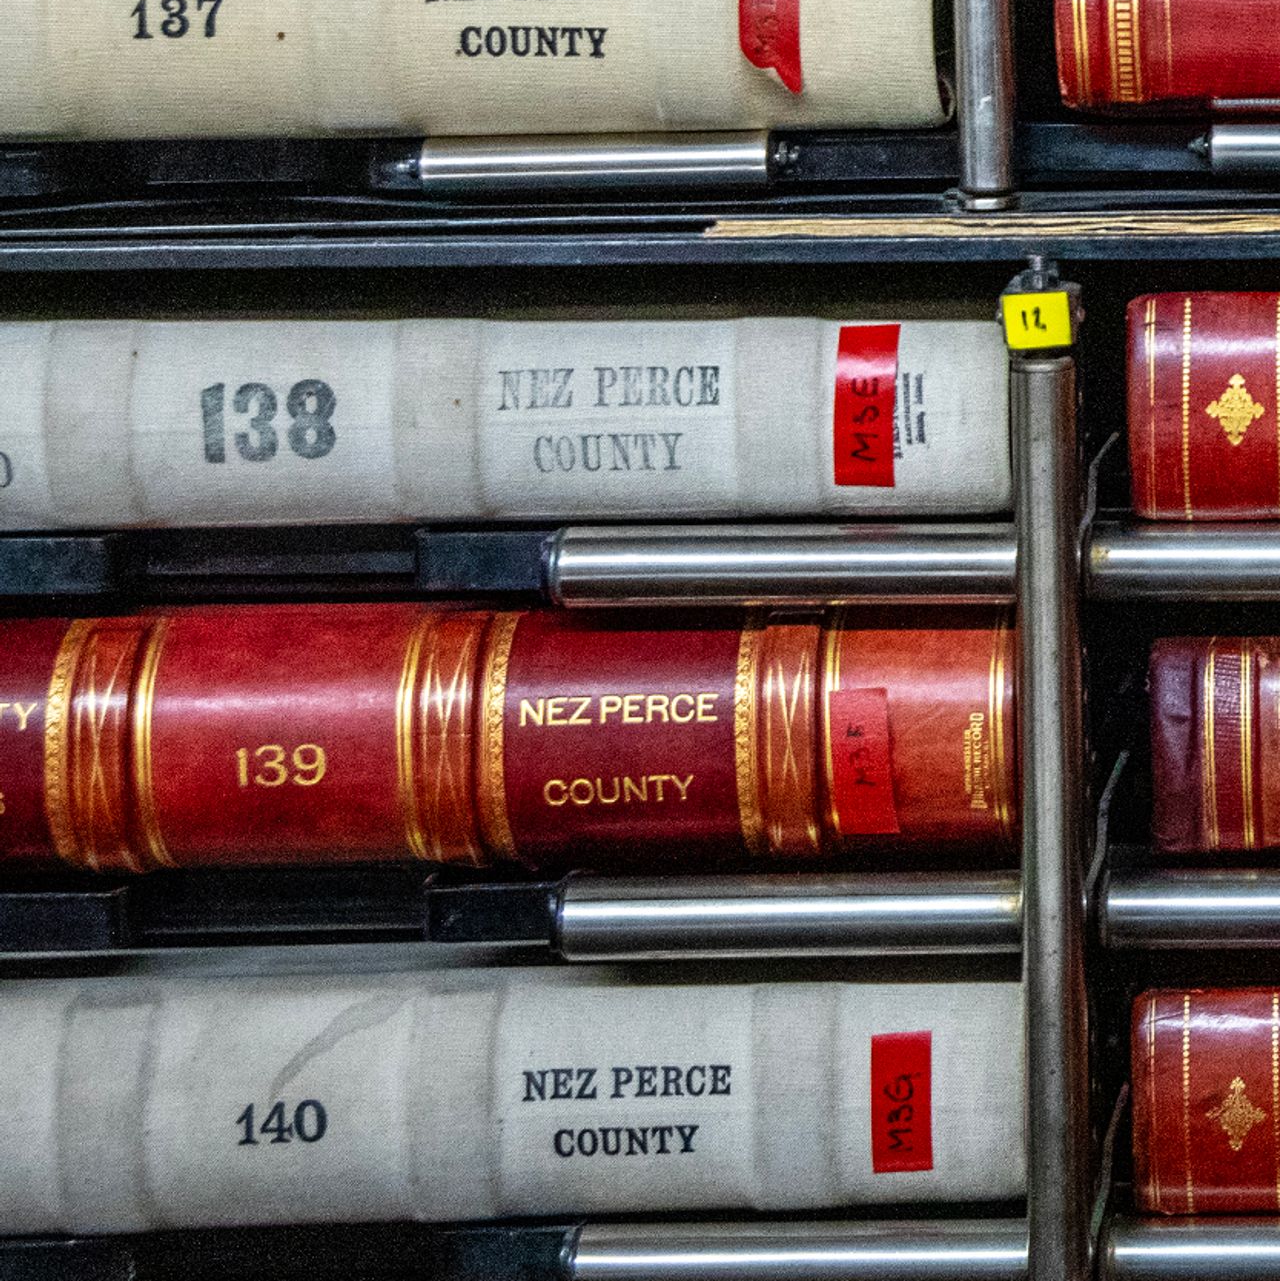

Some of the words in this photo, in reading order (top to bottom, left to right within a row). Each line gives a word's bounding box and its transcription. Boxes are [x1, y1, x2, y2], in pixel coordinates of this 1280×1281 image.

[462, 28, 606, 58] COUNTY
[1021, 306, 1047, 331] 12
[497, 368, 574, 412] NEZ
[594, 366, 721, 407] PERCE
[200, 379, 337, 464] 138
[533, 432, 682, 473] COUNTY
[519, 696, 592, 727] NEZ
[599, 693, 718, 723] PERCE
[235, 743, 327, 788] 139
[543, 774, 694, 806] COUNTY
[521, 1068, 598, 1102] NEZ
[611, 1064, 732, 1098] PERCE
[235, 1100, 327, 1147] 140
[553, 1125, 699, 1156] COUNTY
